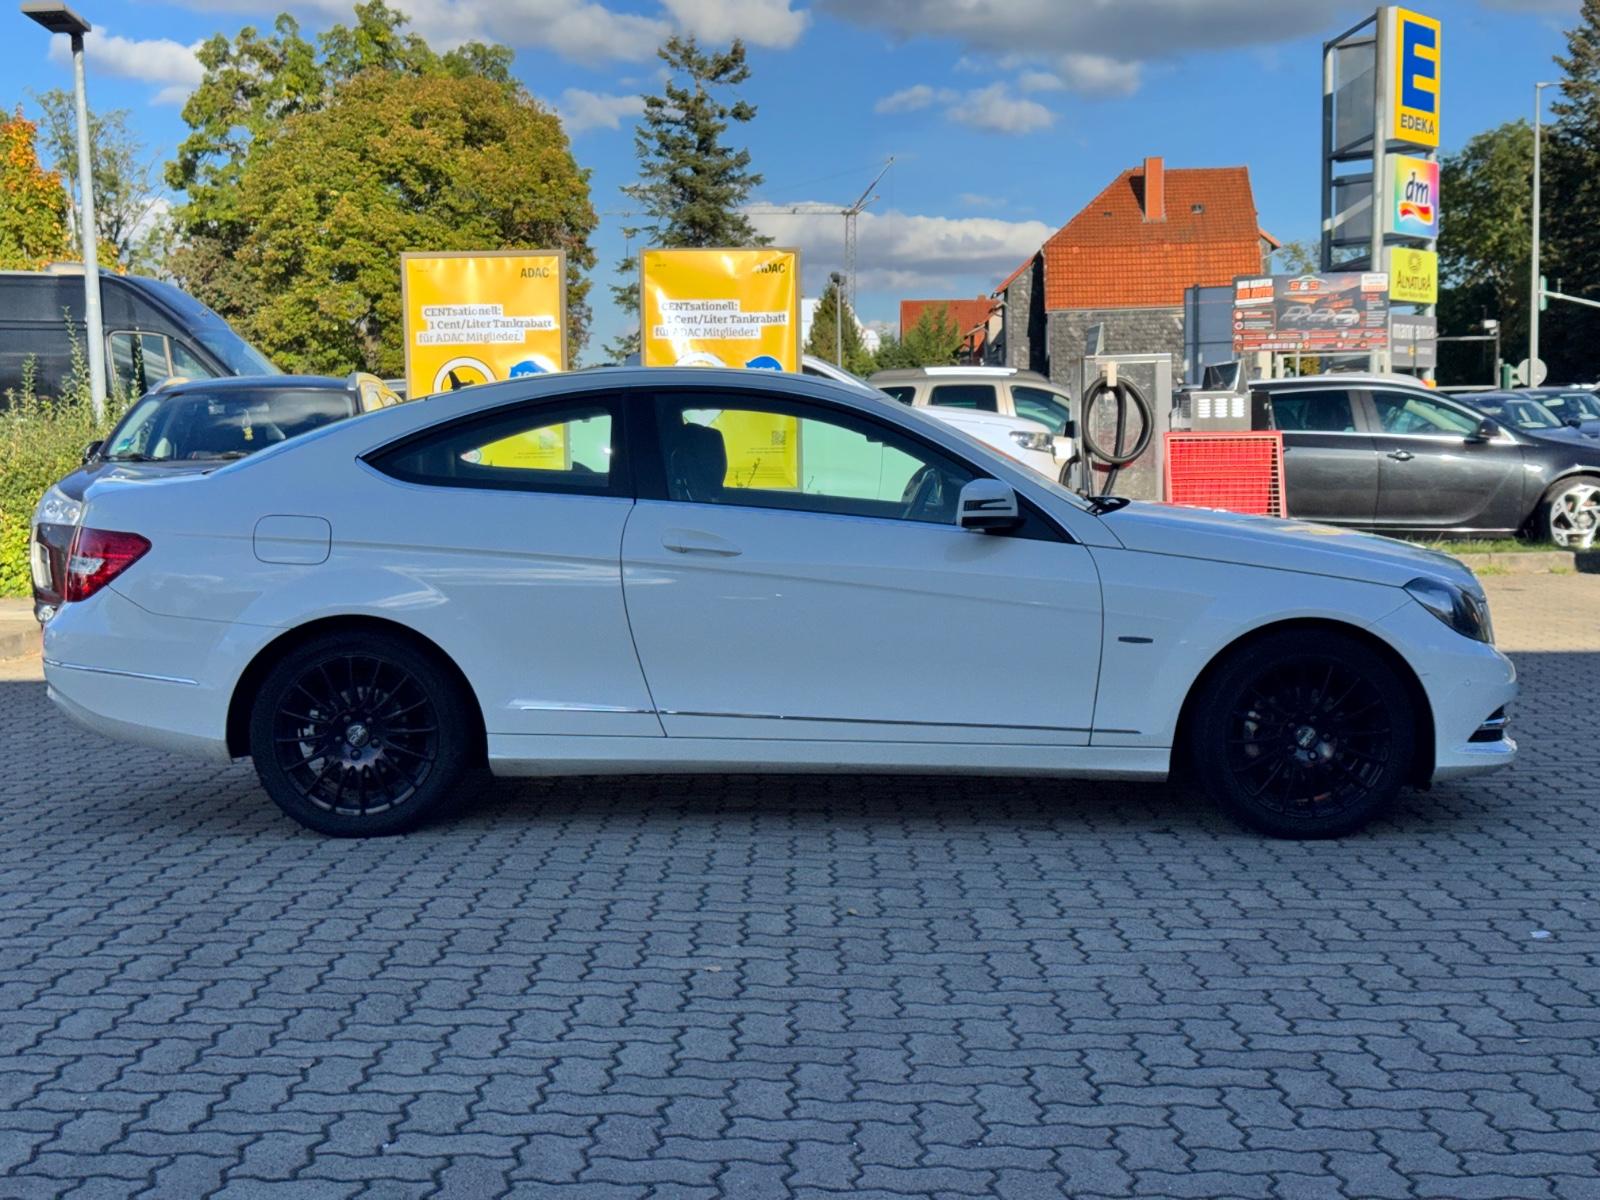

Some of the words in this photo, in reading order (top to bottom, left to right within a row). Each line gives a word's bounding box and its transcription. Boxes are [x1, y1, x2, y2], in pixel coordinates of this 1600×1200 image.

[1402, 20, 1435, 114] E
[1400, 113, 1435, 136] EDEKA
[1405, 171, 1429, 204] dm
[520, 267, 550, 278] ADAC
[423, 306, 502, 317] CENTsationell:
[661, 301, 738, 312] CENTsationell:
[430, 321, 436, 330] 1
[437, 319, 492, 330] Cent/Liter
[493, 318, 552, 329] Tankrabatt
[674, 314, 729, 325] Cent/Liter
[730, 313, 786, 324] Tankrabatt
[419, 332, 435, 343] für
[436, 332, 465, 343] ADAC
